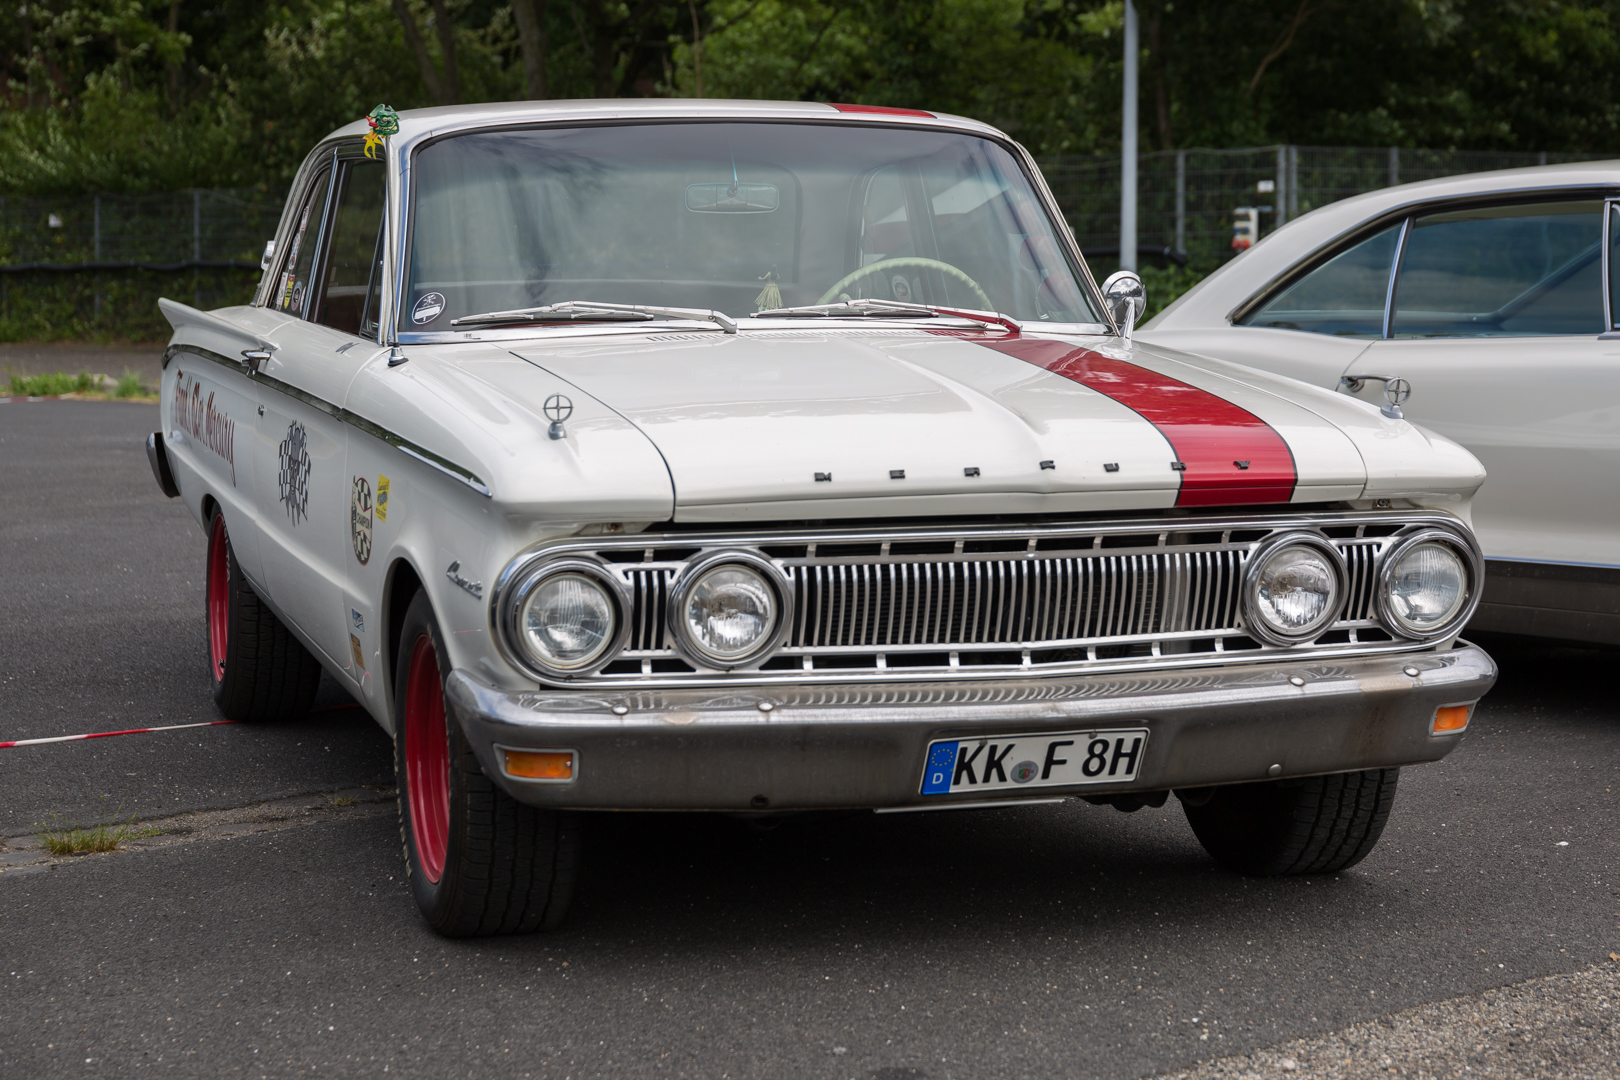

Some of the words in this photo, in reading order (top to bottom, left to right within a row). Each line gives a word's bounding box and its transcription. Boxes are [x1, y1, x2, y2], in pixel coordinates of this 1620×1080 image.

[952, 744, 1016, 785] KK
[1041, 740, 1074, 780] F
[1082, 737, 1142, 777] 8H
[932, 772, 944, 785] D
